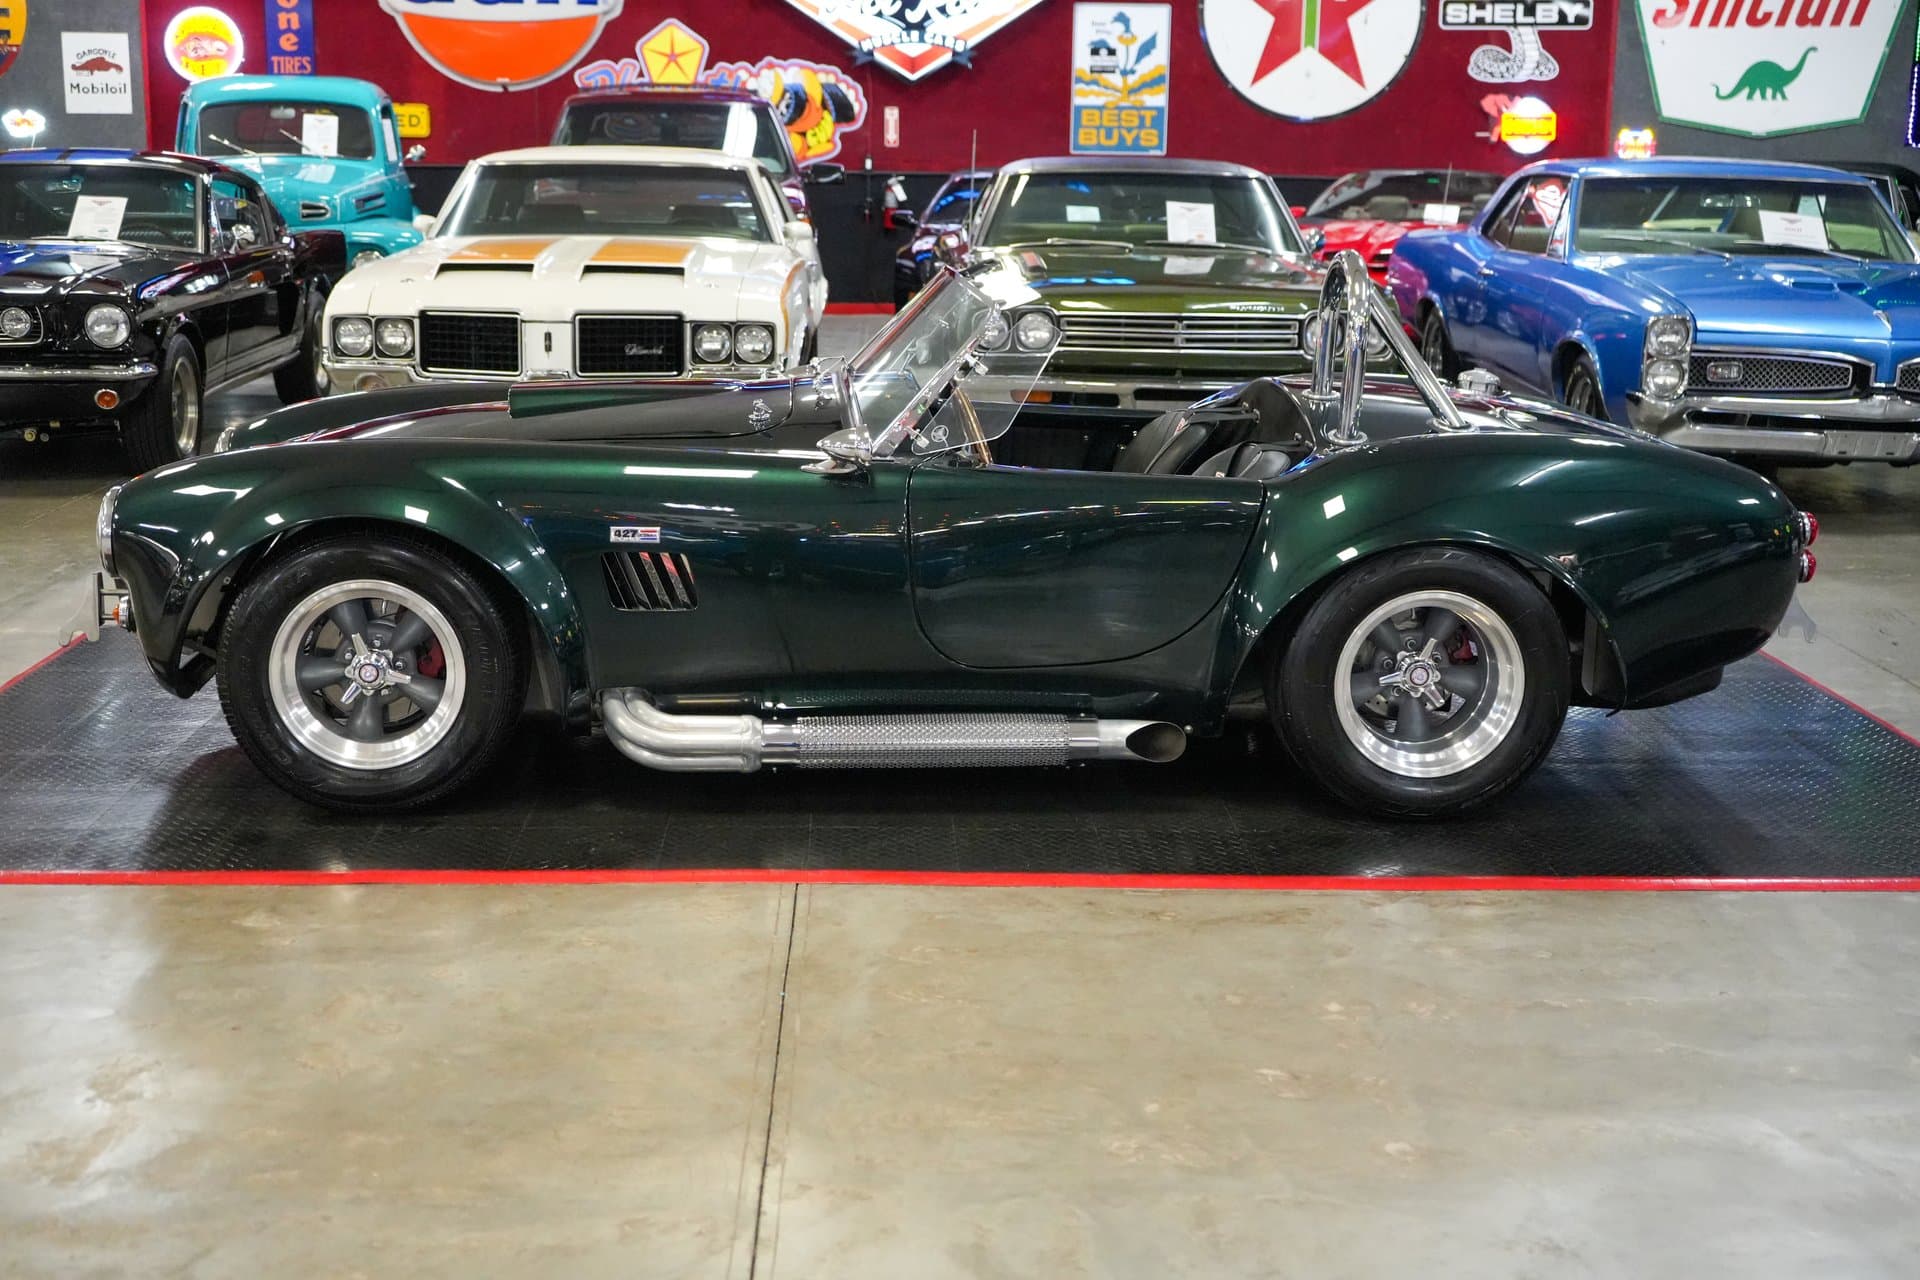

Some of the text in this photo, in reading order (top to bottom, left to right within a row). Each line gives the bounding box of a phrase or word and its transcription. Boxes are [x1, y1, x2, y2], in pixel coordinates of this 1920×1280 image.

[1446, 3, 1584, 23] SHELBY
[860, 30, 967, 53] MUSCLE CARS
[76, 48, 116, 59] GARGOYLE
[271, 56, 311, 74] TIRES
[70, 82, 127, 94] Mobiloil
[1081, 109, 1158, 127] BEST
[1078, 128, 1159, 147] BUYS
[614, 529, 639, 538] 427
